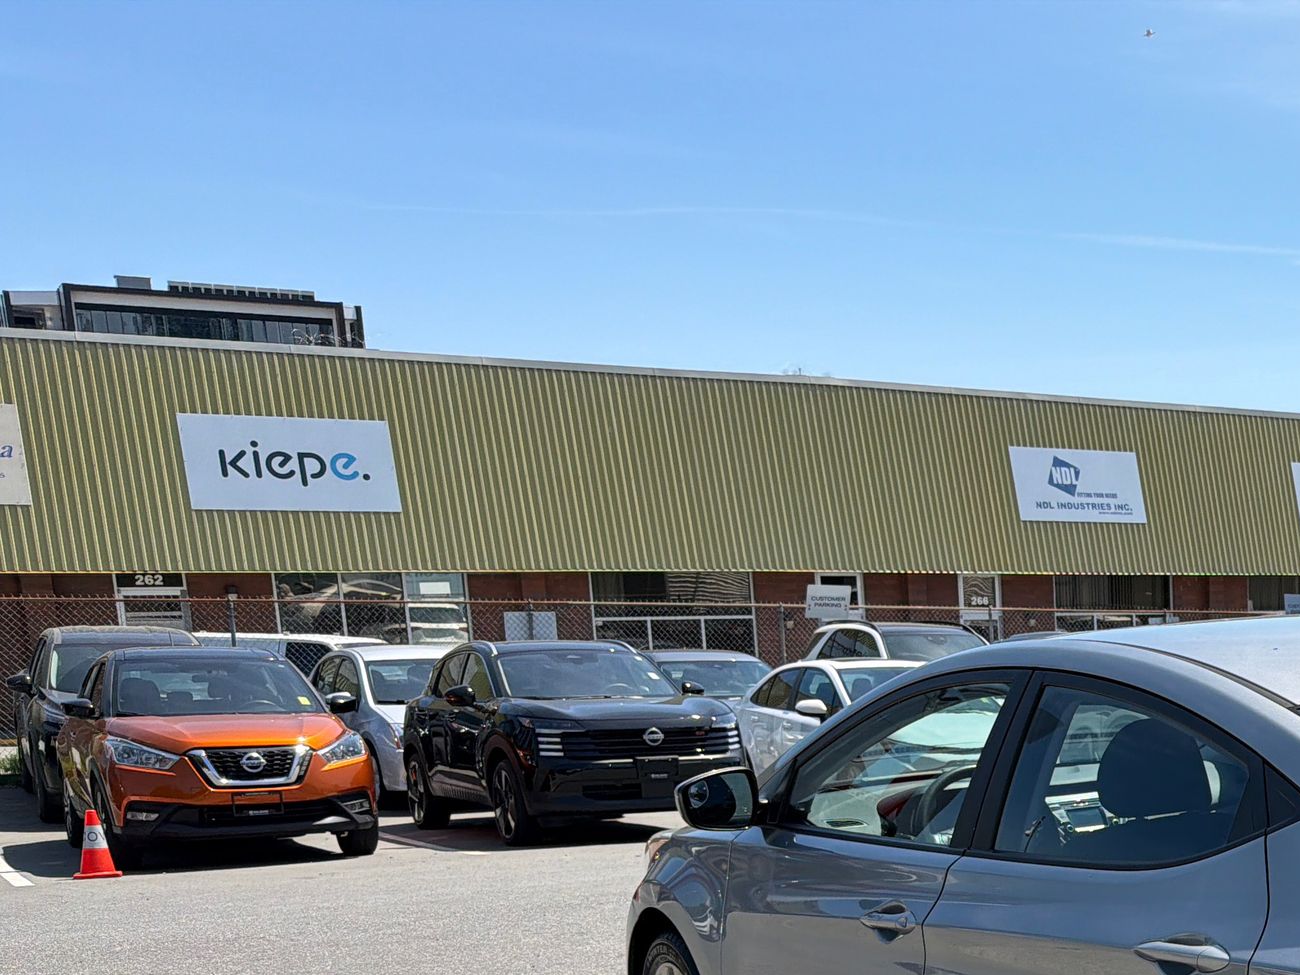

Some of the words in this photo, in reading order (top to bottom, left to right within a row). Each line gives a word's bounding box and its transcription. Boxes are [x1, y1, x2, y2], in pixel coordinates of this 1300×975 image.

[1051, 466, 1079, 485] NDL
[1036, 501, 1055, 510] NDL
[1057, 502, 1112, 511] INDUSTRIES
[1114, 503, 1133, 512] INC.
[134, 574, 164, 586] 262
